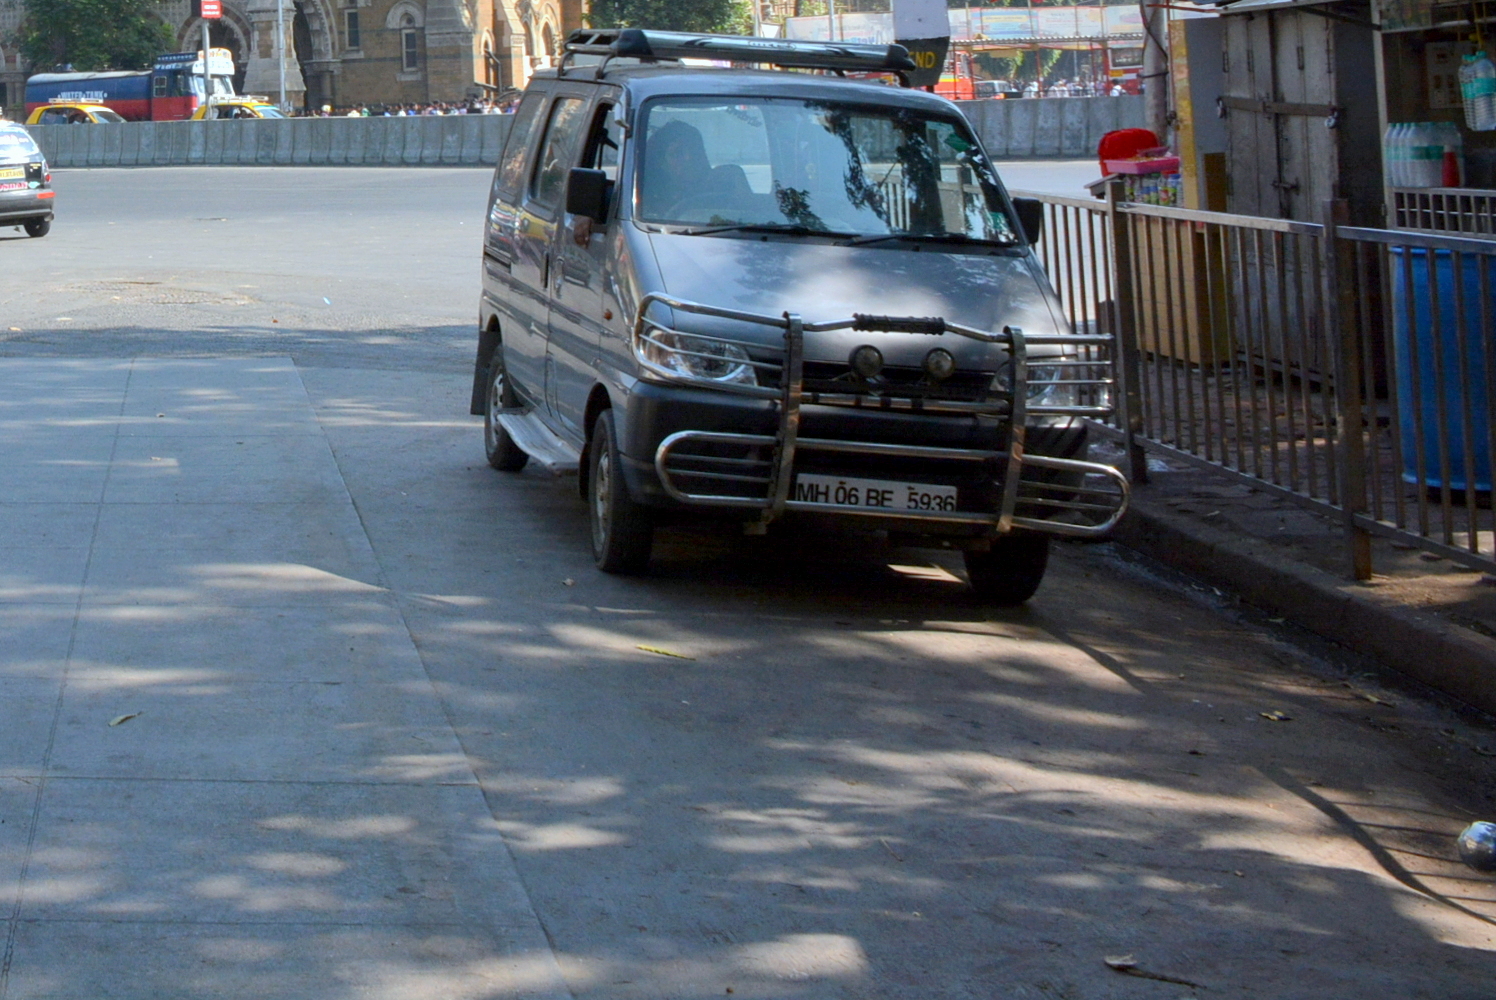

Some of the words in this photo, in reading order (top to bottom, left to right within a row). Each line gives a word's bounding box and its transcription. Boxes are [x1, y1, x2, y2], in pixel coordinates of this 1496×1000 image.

[61, 91, 83, 100] WATER
[85, 90, 104, 100] TANK
[797, 483, 829, 502] MH
[835, 485, 859, 505] 06
[866, 488, 894, 508] BE
[907, 490, 955, 511] 5936
